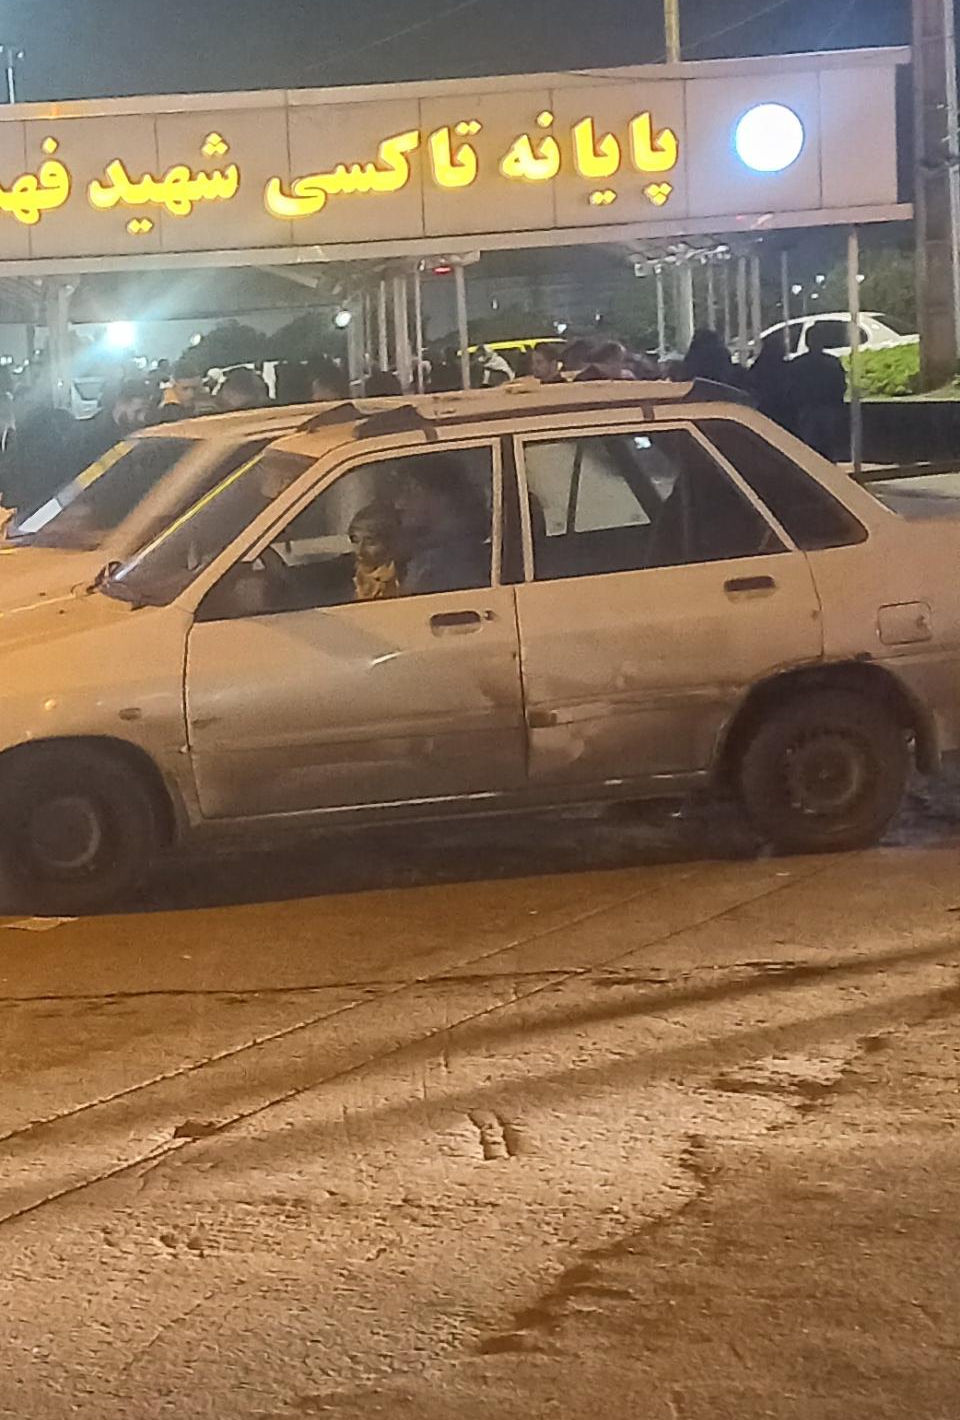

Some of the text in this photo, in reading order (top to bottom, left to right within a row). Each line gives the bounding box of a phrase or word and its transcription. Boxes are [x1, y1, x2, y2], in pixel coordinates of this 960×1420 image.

[88, 132, 240, 235] شهید
[263, 119, 481, 219] تاکسی
[499, 111, 679, 206] پایانه
